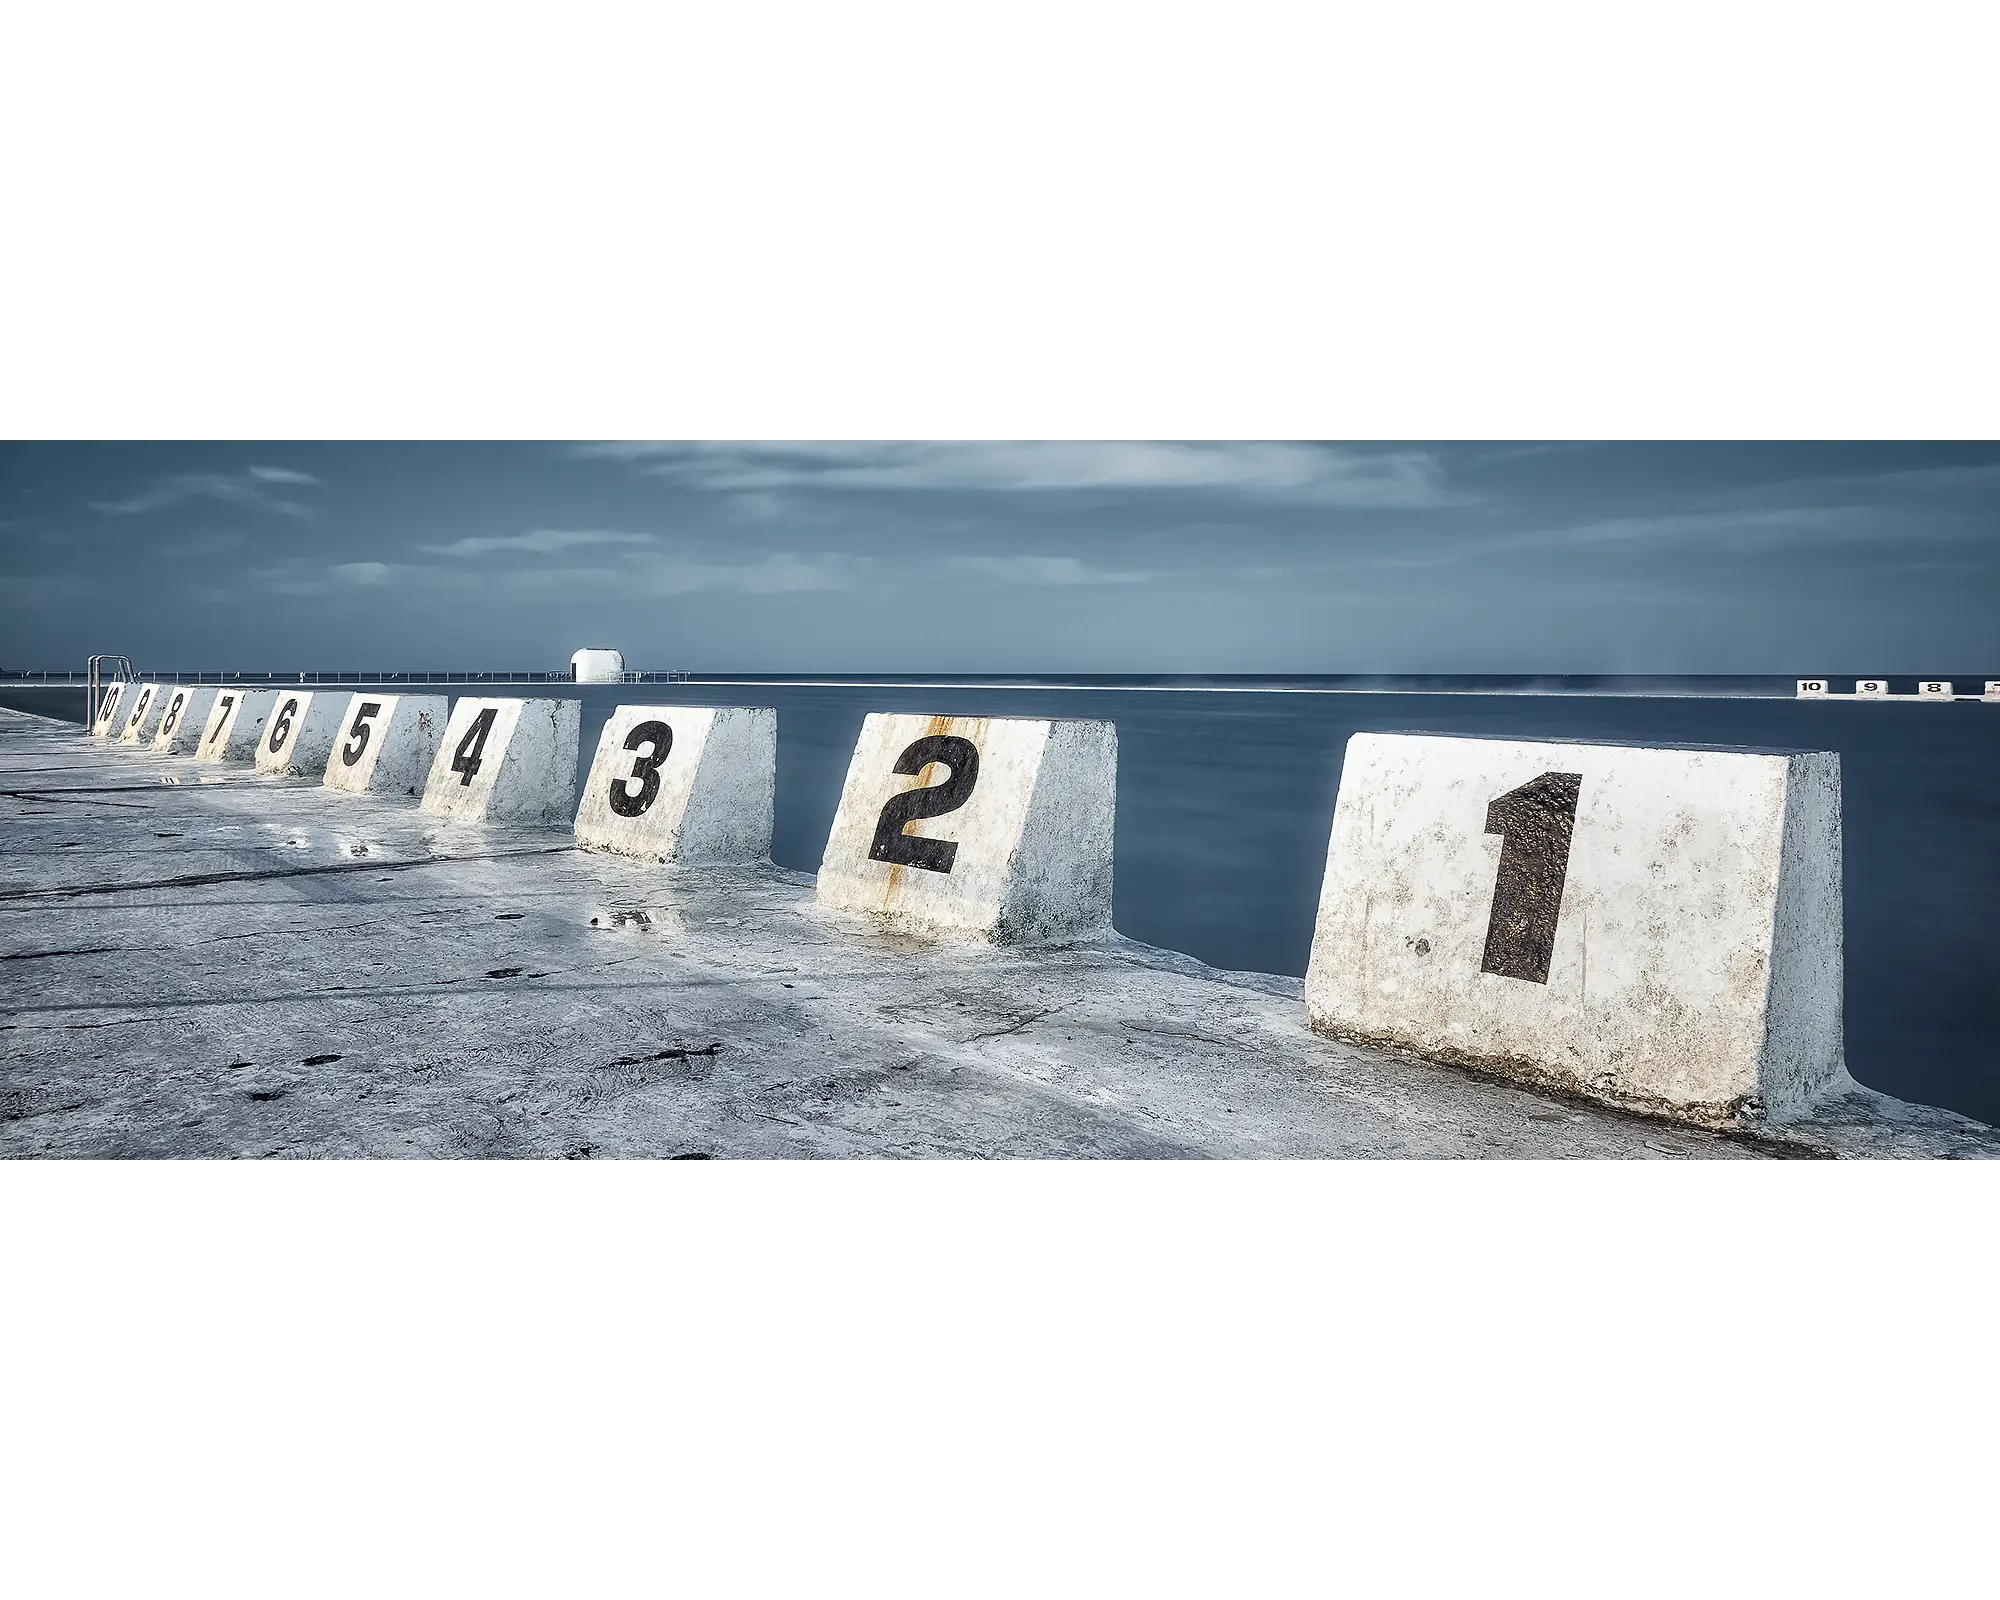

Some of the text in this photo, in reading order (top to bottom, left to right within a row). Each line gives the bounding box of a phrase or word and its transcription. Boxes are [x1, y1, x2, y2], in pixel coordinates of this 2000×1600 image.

[99, 686, 119, 721] 10
[131, 689, 151, 726] 9
[1801, 682, 1822, 691] 10
[1863, 682, 1878, 692] 9
[1927, 683, 1942, 692] 8
[163, 693, 184, 736] 8
[208, 695, 235, 744] 7
[269, 698, 298, 753] 6
[342, 703, 381, 766] 5
[450, 708, 498, 787] 4
[609, 721, 673, 817] 3
[868, 735, 979, 874] 2
[1481, 772, 1583, 985] 1
